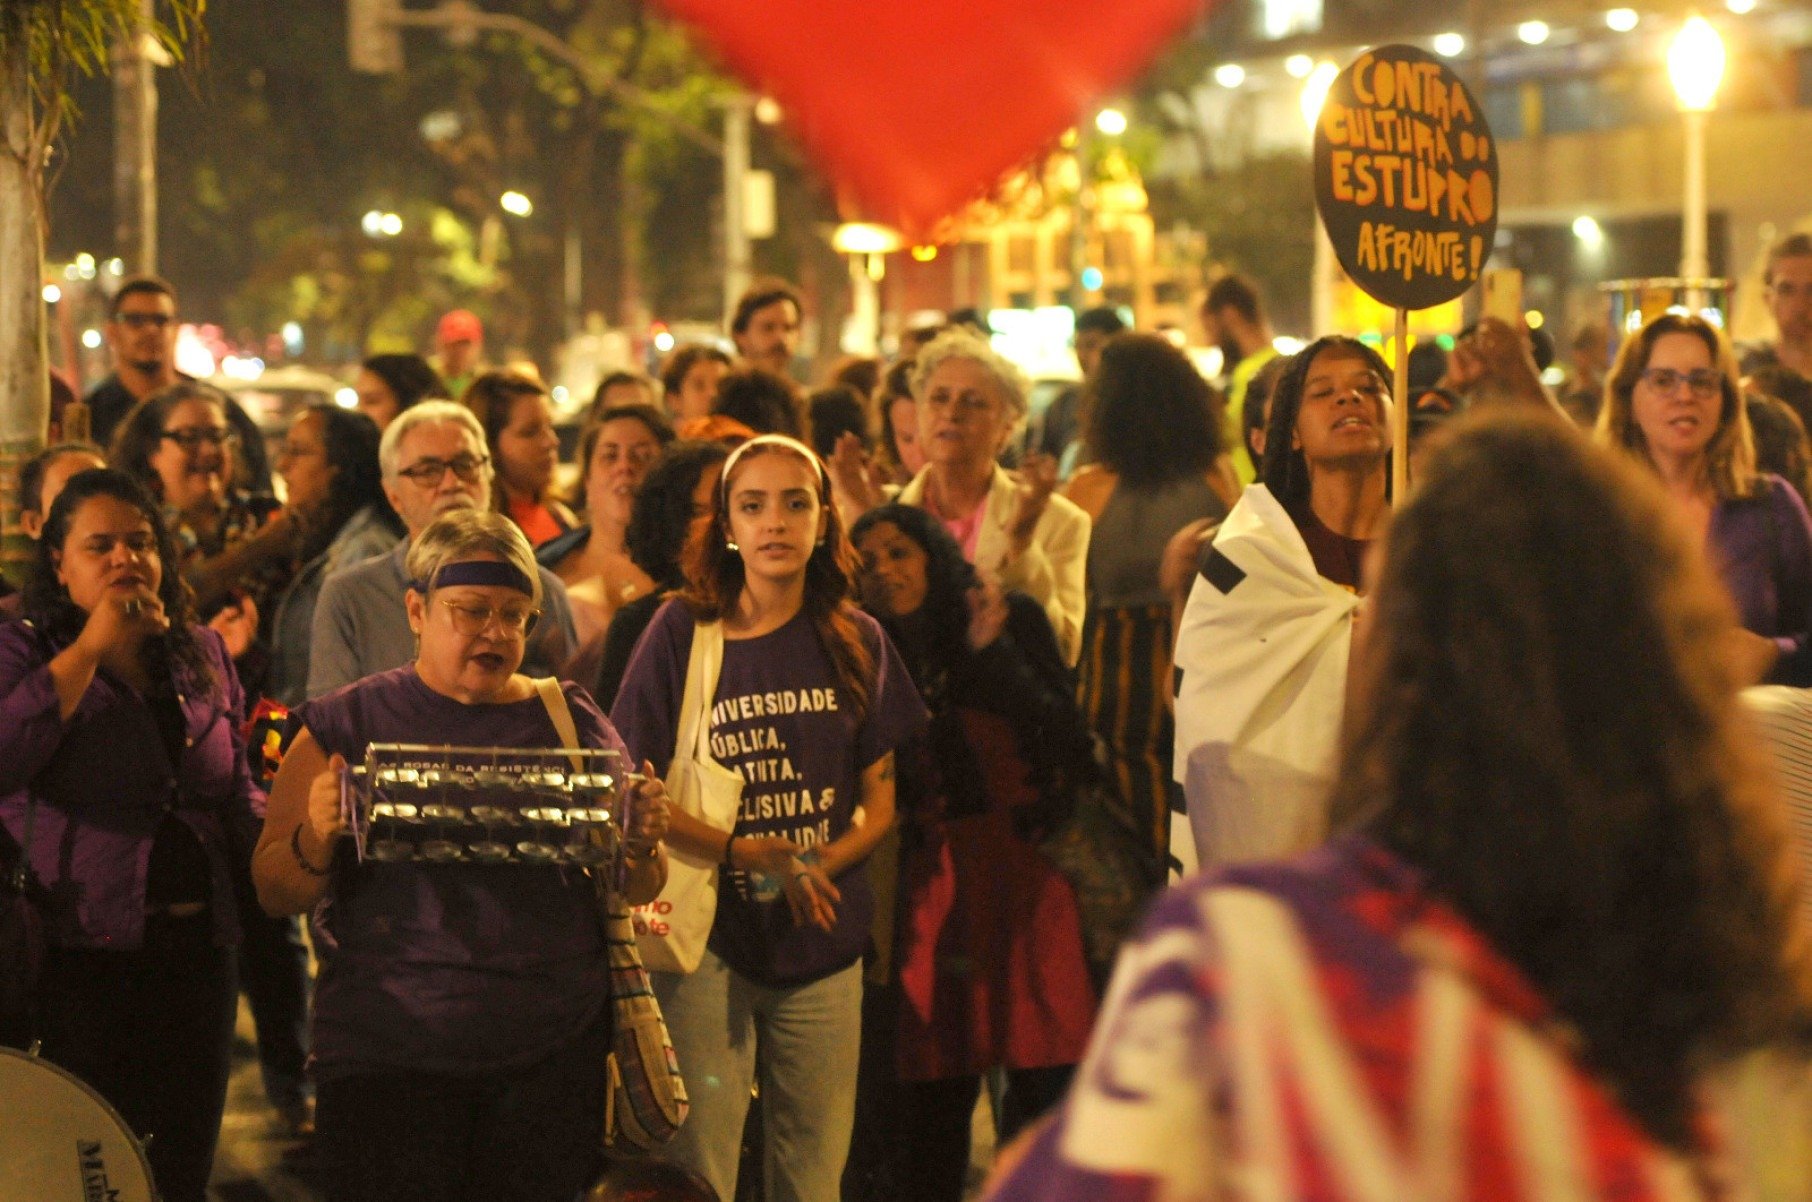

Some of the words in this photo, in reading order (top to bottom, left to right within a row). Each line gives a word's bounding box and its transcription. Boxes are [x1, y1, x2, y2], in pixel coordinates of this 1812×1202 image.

[1353, 53, 1474, 132] CONTRA
[1323, 103, 1454, 168] CULTURA
[1332, 151, 1493, 227] ESTUPRO
[1358, 221, 1483, 281] AFRONTE!
[711, 688, 838, 728] NIVERSIDADE
[456, 764, 474, 773] DA
[711, 727, 786, 758] ÚBLICA,
